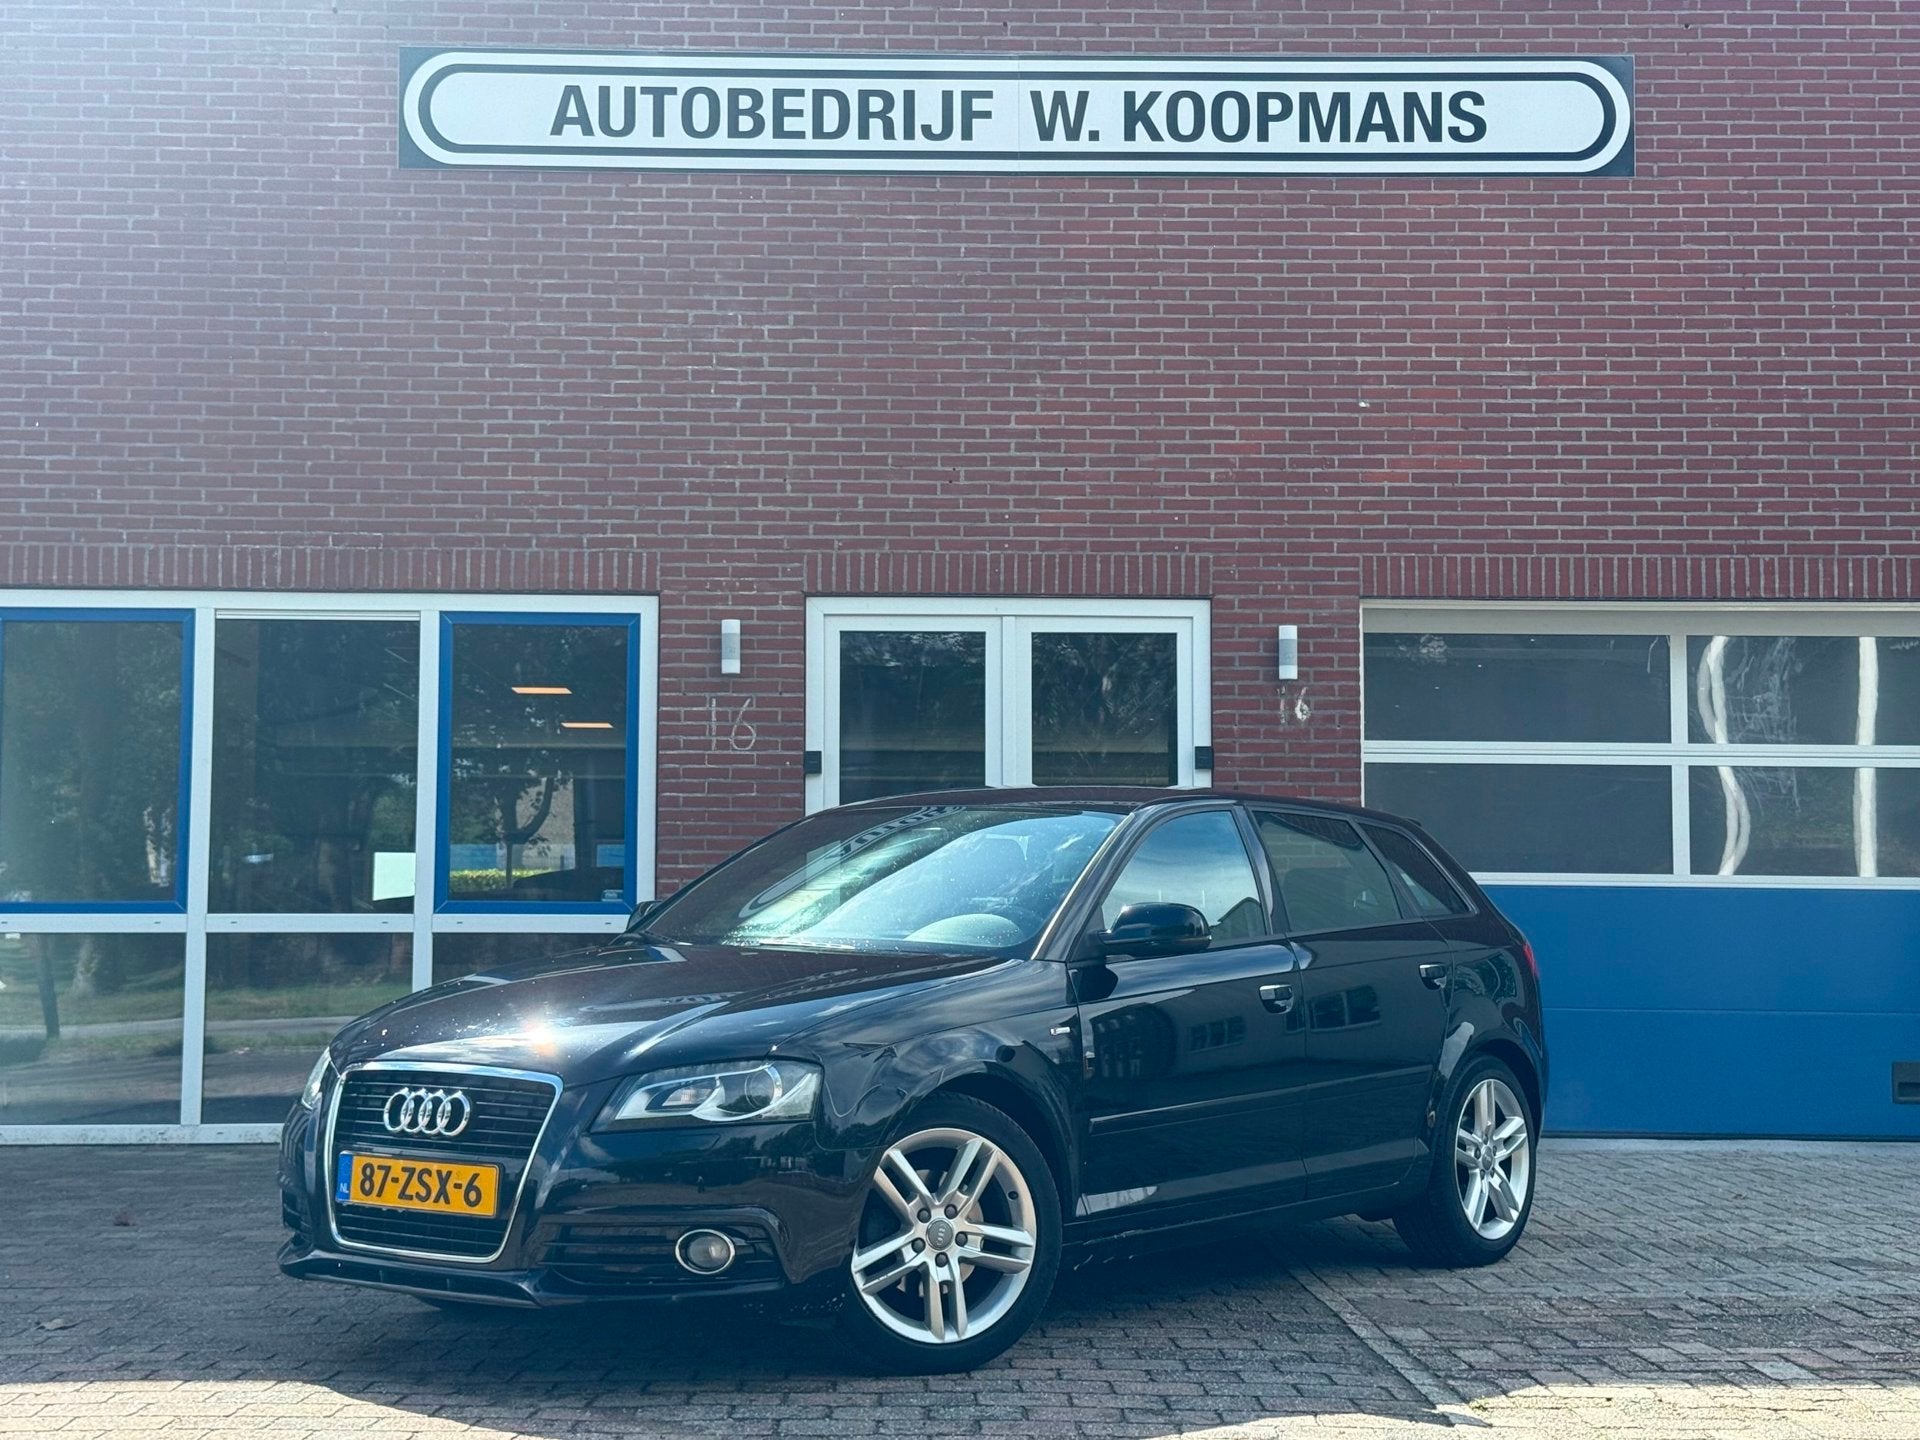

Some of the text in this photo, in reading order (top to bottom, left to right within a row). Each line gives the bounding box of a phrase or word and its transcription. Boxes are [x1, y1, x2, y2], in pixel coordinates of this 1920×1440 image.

[550, 84, 1488, 143] AUTOBEDRIJF W. KOOPMANS
[711, 697, 757, 751] 16
[339, 1182, 350, 1194] NL
[359, 1162, 482, 1208] 87-ZSX-6
